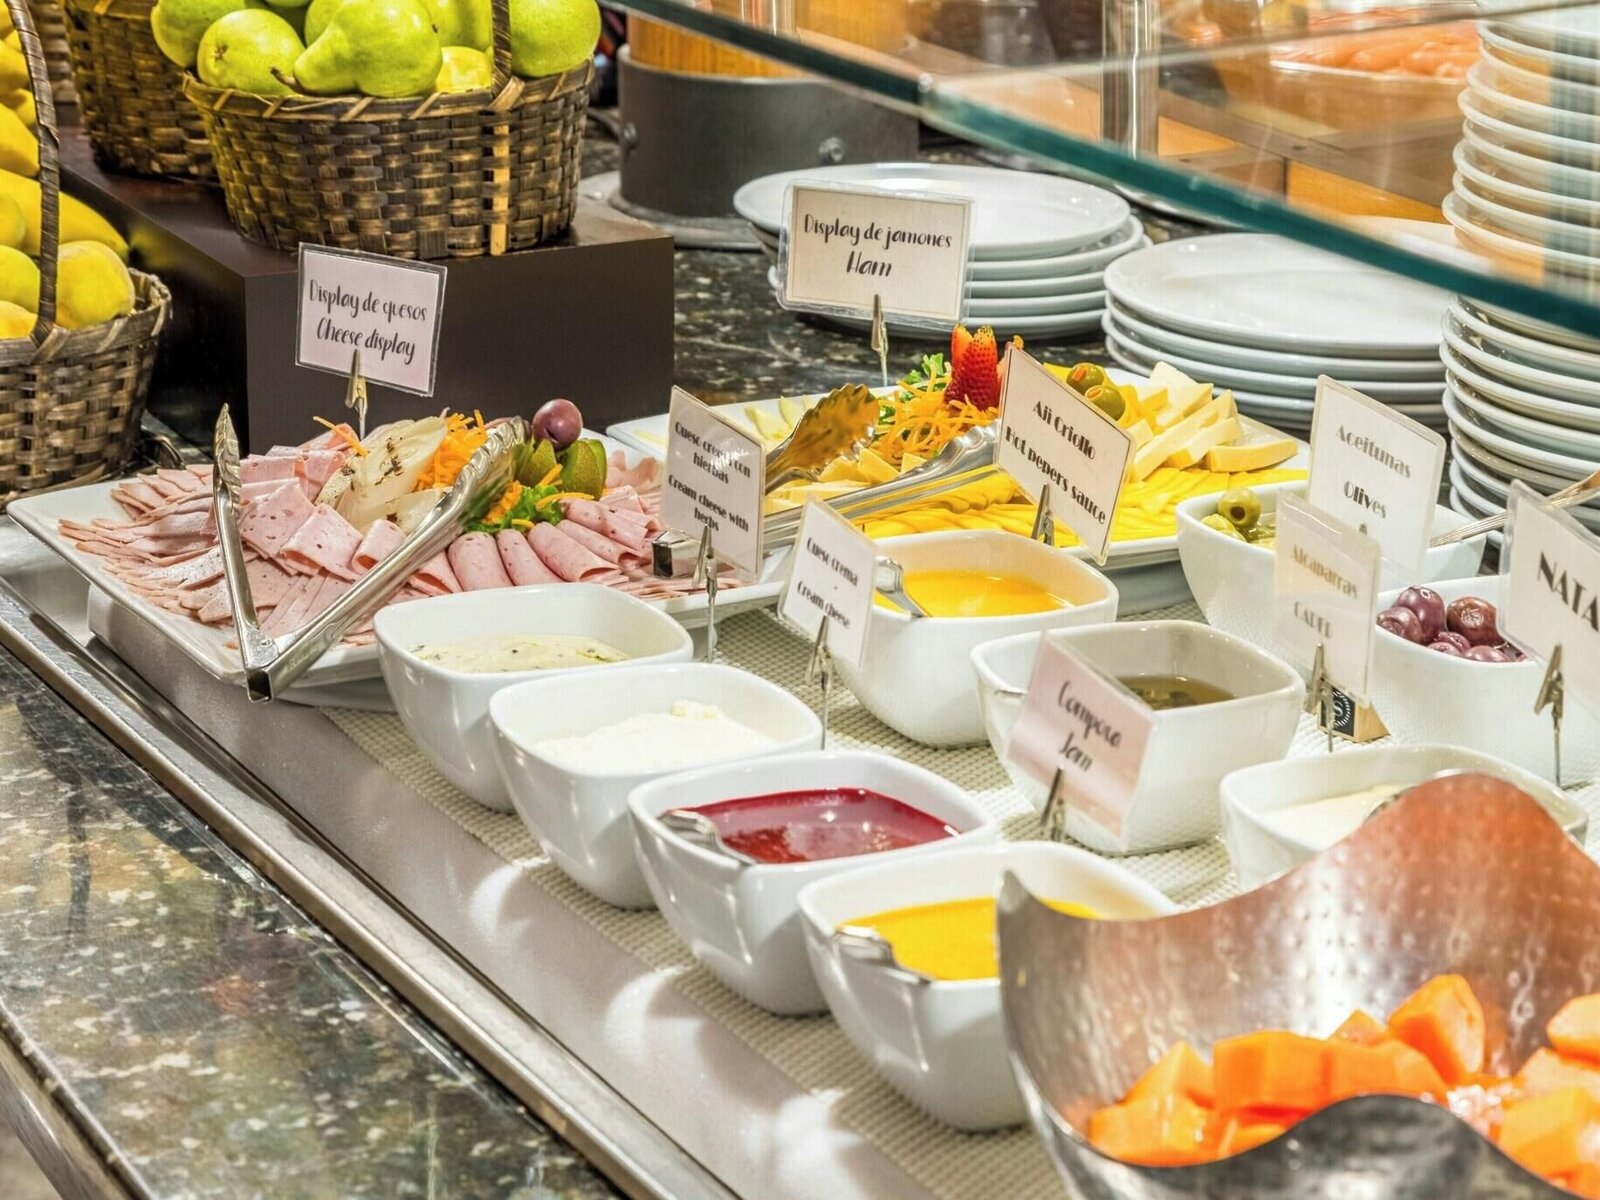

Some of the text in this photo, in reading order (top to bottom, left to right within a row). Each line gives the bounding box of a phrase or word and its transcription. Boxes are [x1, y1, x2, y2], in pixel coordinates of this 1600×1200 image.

[804, 213, 952, 250] Display de jamones
[846, 250, 892, 277] Ham
[309, 279, 427, 323] Display de quesos
[317, 317, 415, 365] Cheese display
[675, 421, 701, 448] Queso
[734, 459, 751, 478] con
[1054, 416, 1096, 460] Criollo
[1336, 425, 1411, 478] Aceitunas
[1005, 426, 1106, 525] Hot pepers sauce
[668, 474, 749, 532] Cream cheese with
[694, 507, 719, 532] herbs
[1343, 481, 1386, 518] Olives
[831, 560, 858, 587] crema
[1291, 544, 1358, 598] Alcaparras
[797, 580, 850, 629] Cream cheese
[1059, 732, 1093, 772] Jam
